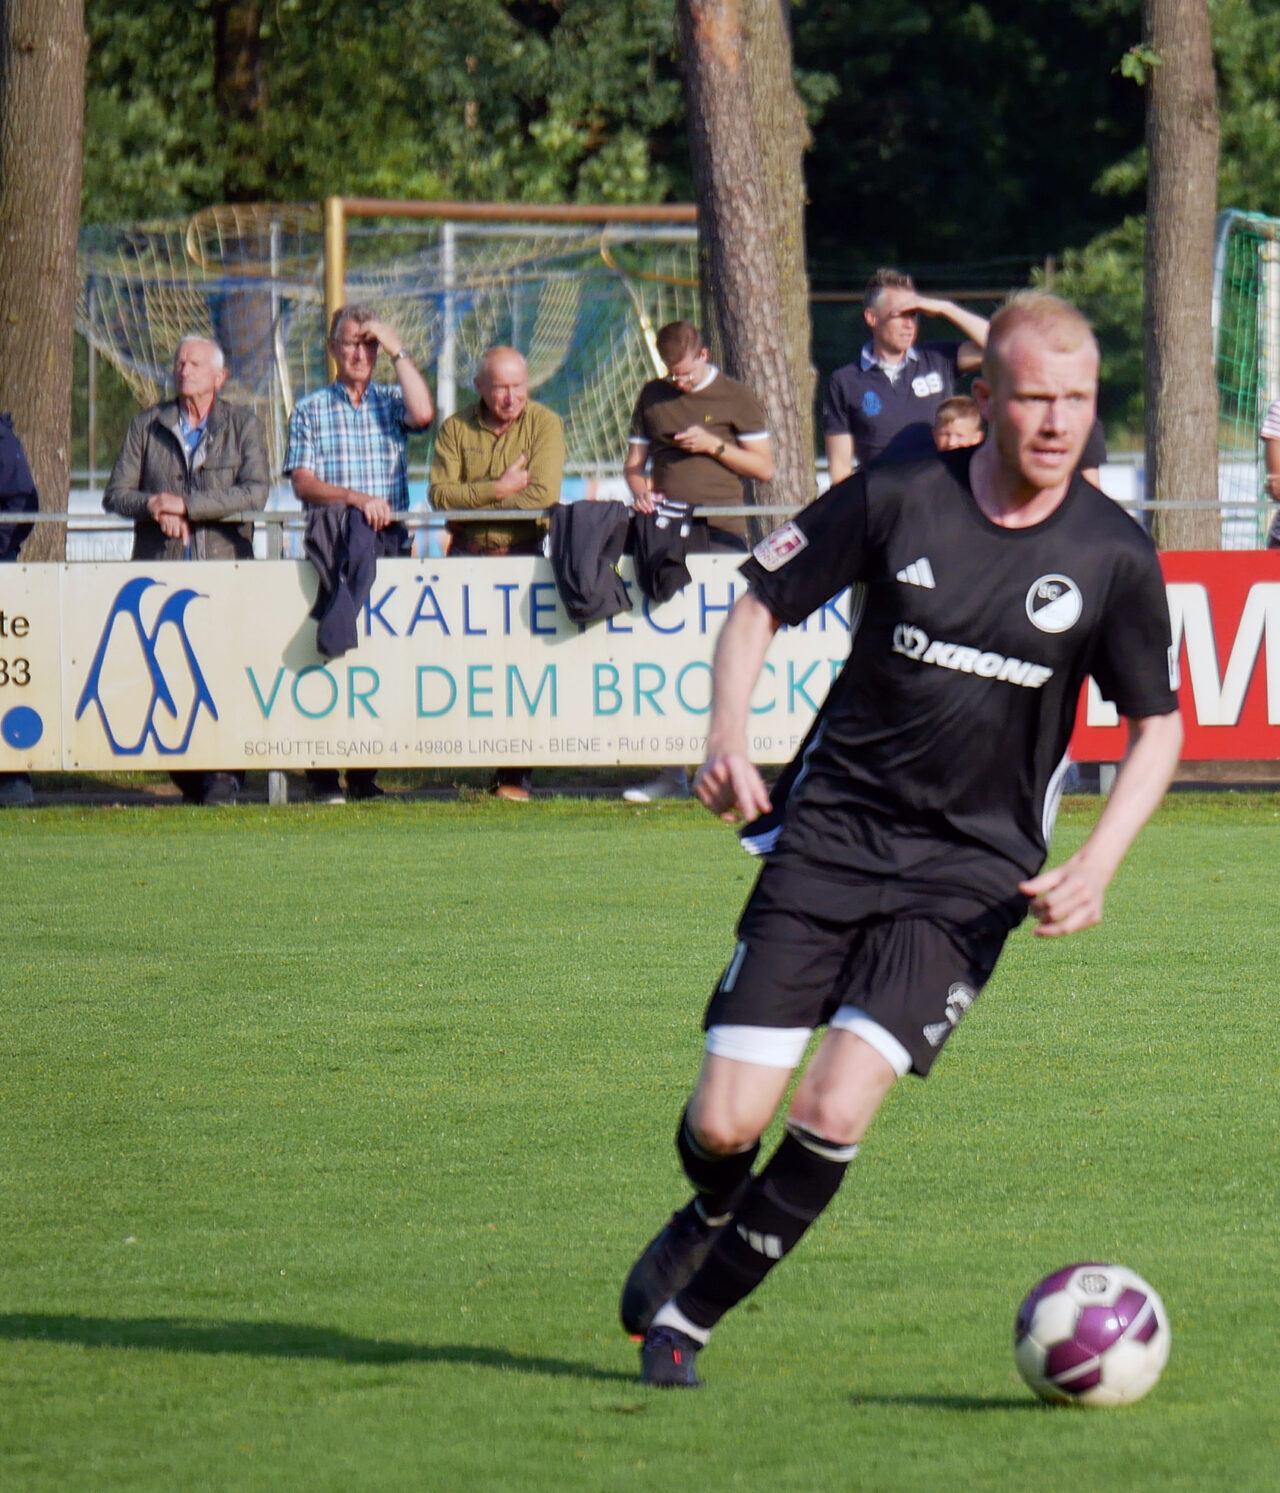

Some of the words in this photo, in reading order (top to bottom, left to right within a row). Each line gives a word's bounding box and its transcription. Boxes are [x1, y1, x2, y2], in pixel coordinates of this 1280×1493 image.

[363, 574, 851, 637] KÄLTECHK
[245, 664, 380, 719] VOR
[415, 663, 558, 718] DEM
[592, 660, 848, 716] BROCK
[922, 640, 1054, 688] KRONE
[244, 736, 384, 757] SCHÜTTELSAND
[389, 740, 398, 754] 4
[414, 739, 463, 754] 49808
[468, 738, 533, 754] LINGEN
[549, 737, 601, 753] BIENE
[618, 736, 644, 751] Ruf
[650, 736, 659, 751] 0
[665, 736, 684, 750] 59
